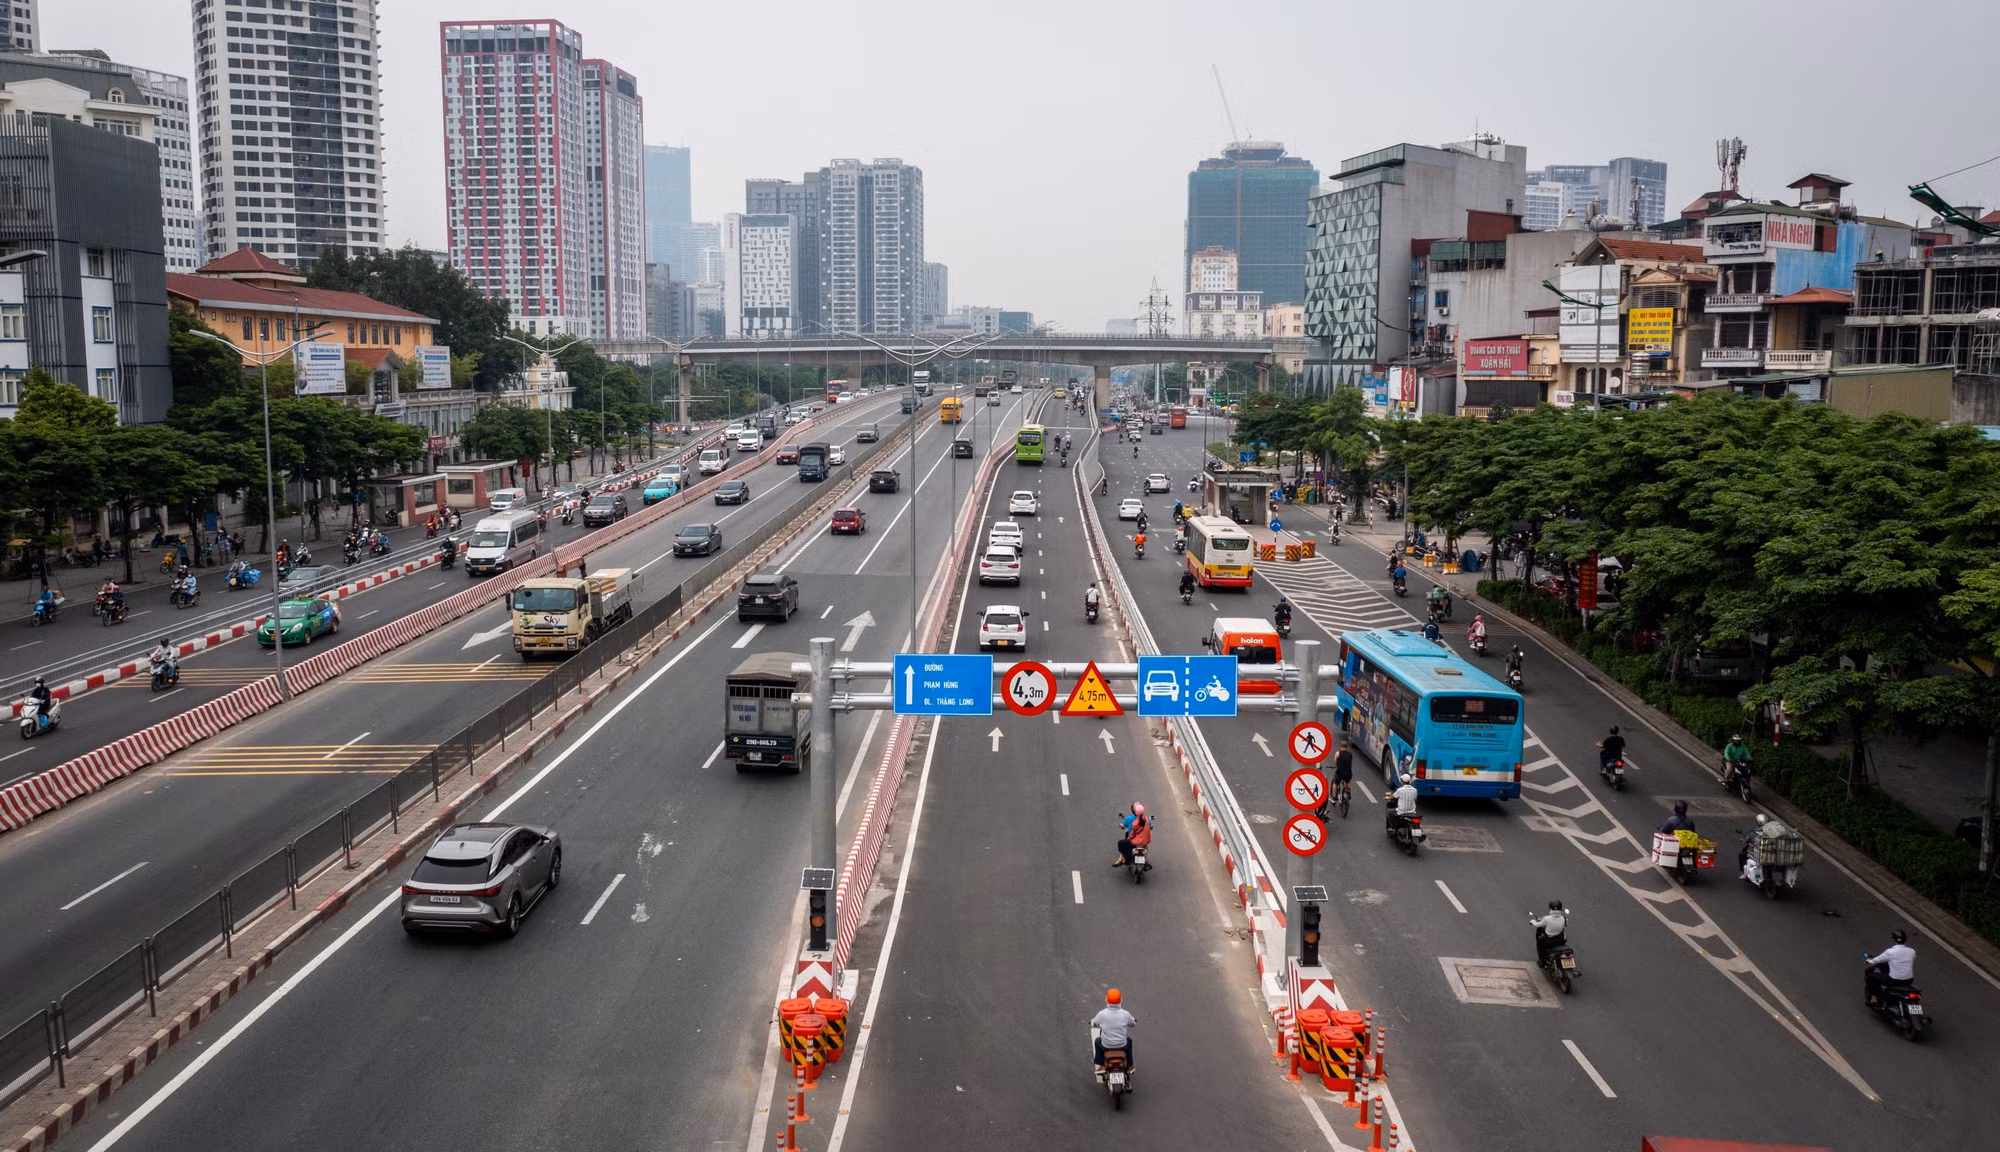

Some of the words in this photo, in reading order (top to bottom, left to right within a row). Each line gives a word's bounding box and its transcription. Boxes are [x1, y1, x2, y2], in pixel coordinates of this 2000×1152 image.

[1767, 218, 1788, 242] NHÀ
[544, 615, 560, 625] Sky
[924, 662, 944, 672] ĐƯỜNG
[924, 681, 941, 690] PHẠM
[943, 680, 959, 689] HÙNG
[958, 698, 974, 706] LONG
